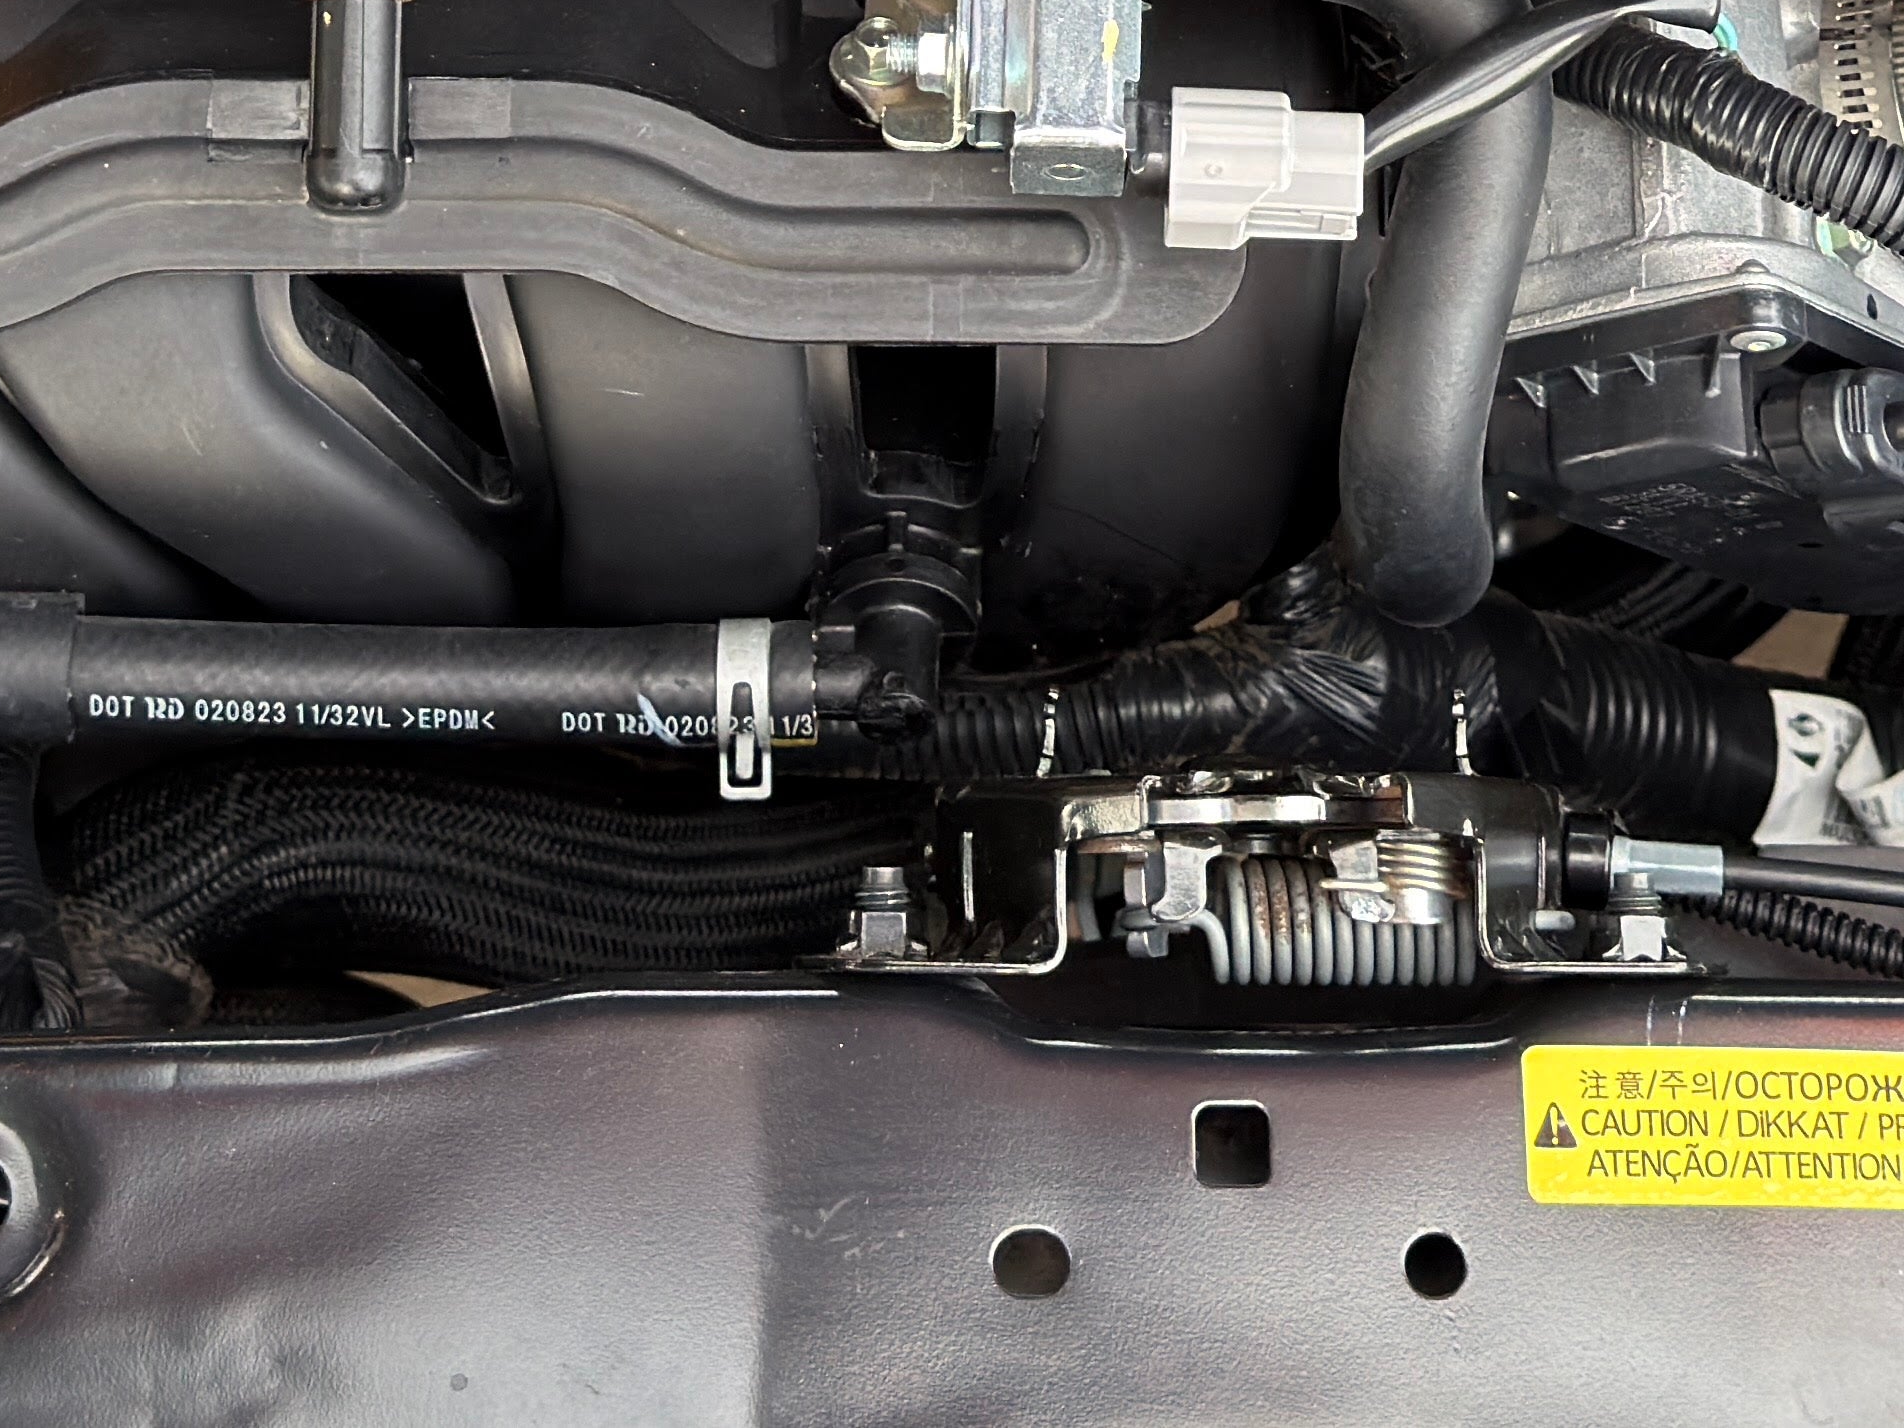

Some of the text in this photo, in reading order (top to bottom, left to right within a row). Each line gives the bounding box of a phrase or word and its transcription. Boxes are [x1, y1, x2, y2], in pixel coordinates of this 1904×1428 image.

[88, 693, 135, 719] DOT
[194, 698, 287, 725] 020823
[295, 703, 392, 729] 11/32VL
[401, 706, 497, 731] >EPDM<
[561, 711, 606, 733] DOT
[1581, 1108, 1709, 1137] CAUTION
